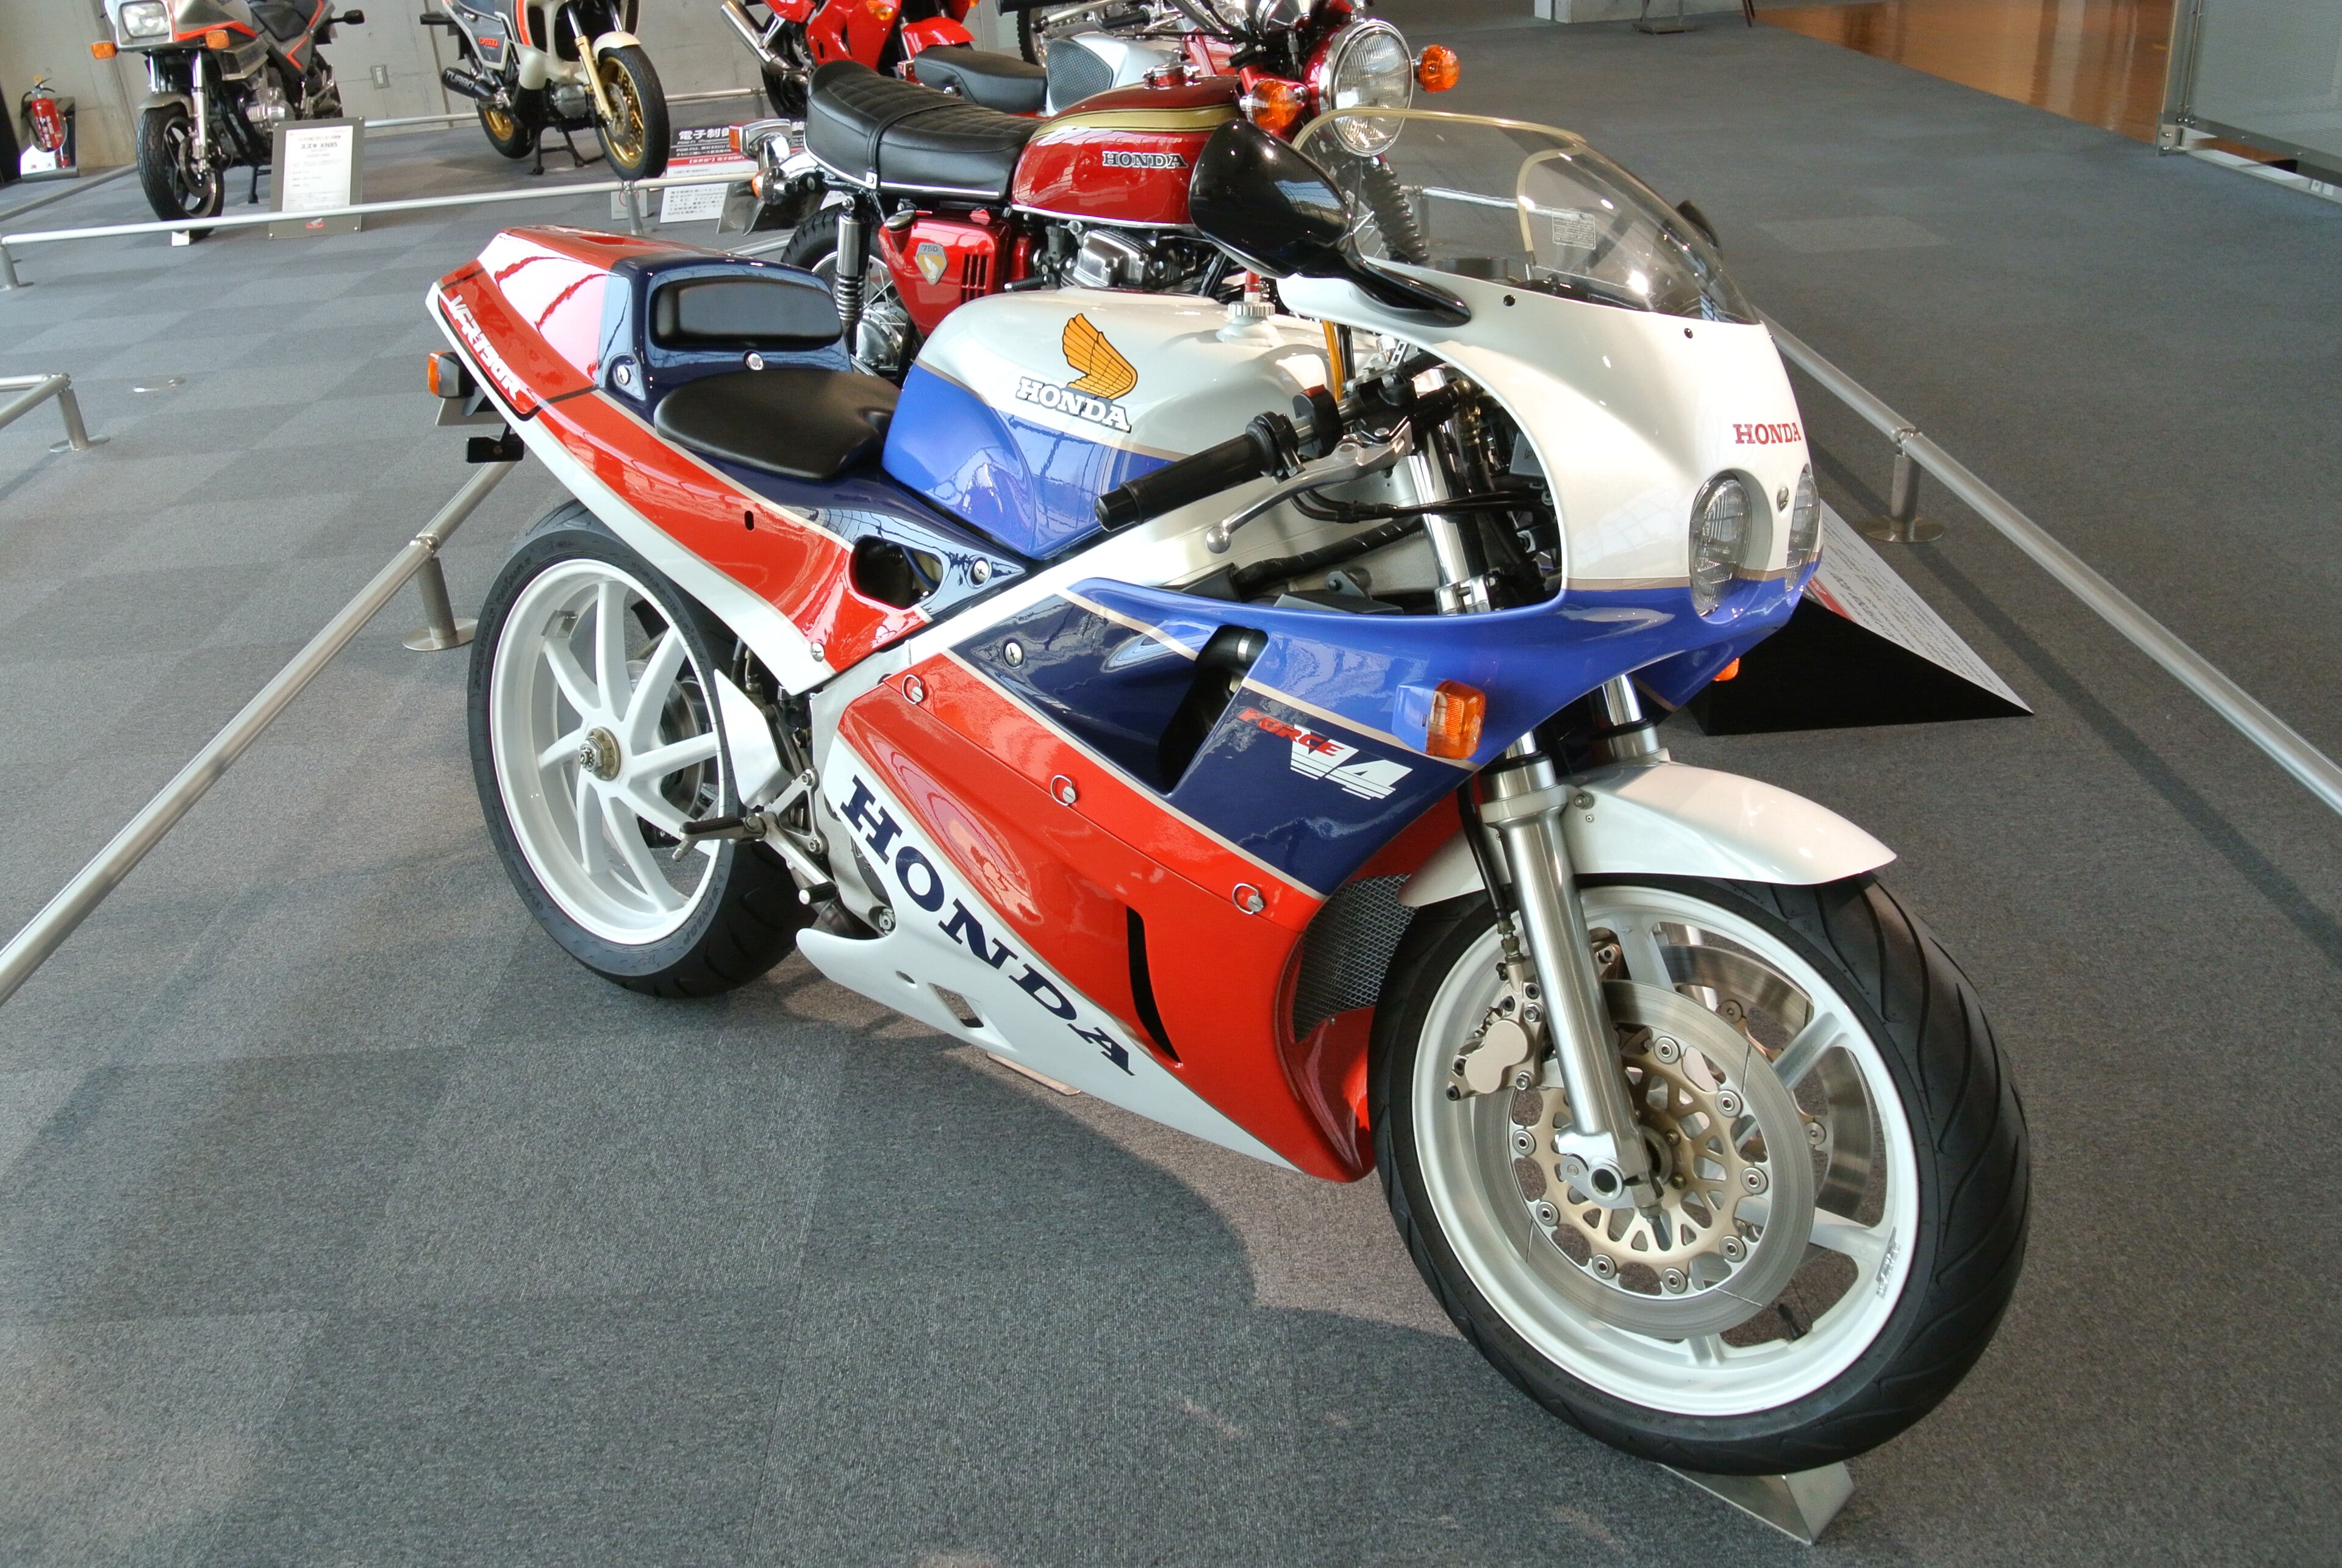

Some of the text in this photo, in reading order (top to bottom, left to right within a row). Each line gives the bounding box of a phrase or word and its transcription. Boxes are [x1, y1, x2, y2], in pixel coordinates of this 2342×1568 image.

[446, 70, 475, 90] TURBO
[1102, 151, 1189, 168] HONDA
[1015, 376, 1132, 434] HONDA
[1733, 423, 1802, 445] HONDA
[1237, 707, 1345, 757] FORCE
[1290, 724, 1413, 800] V4
[840, 775, 1136, 1076] HONDA
